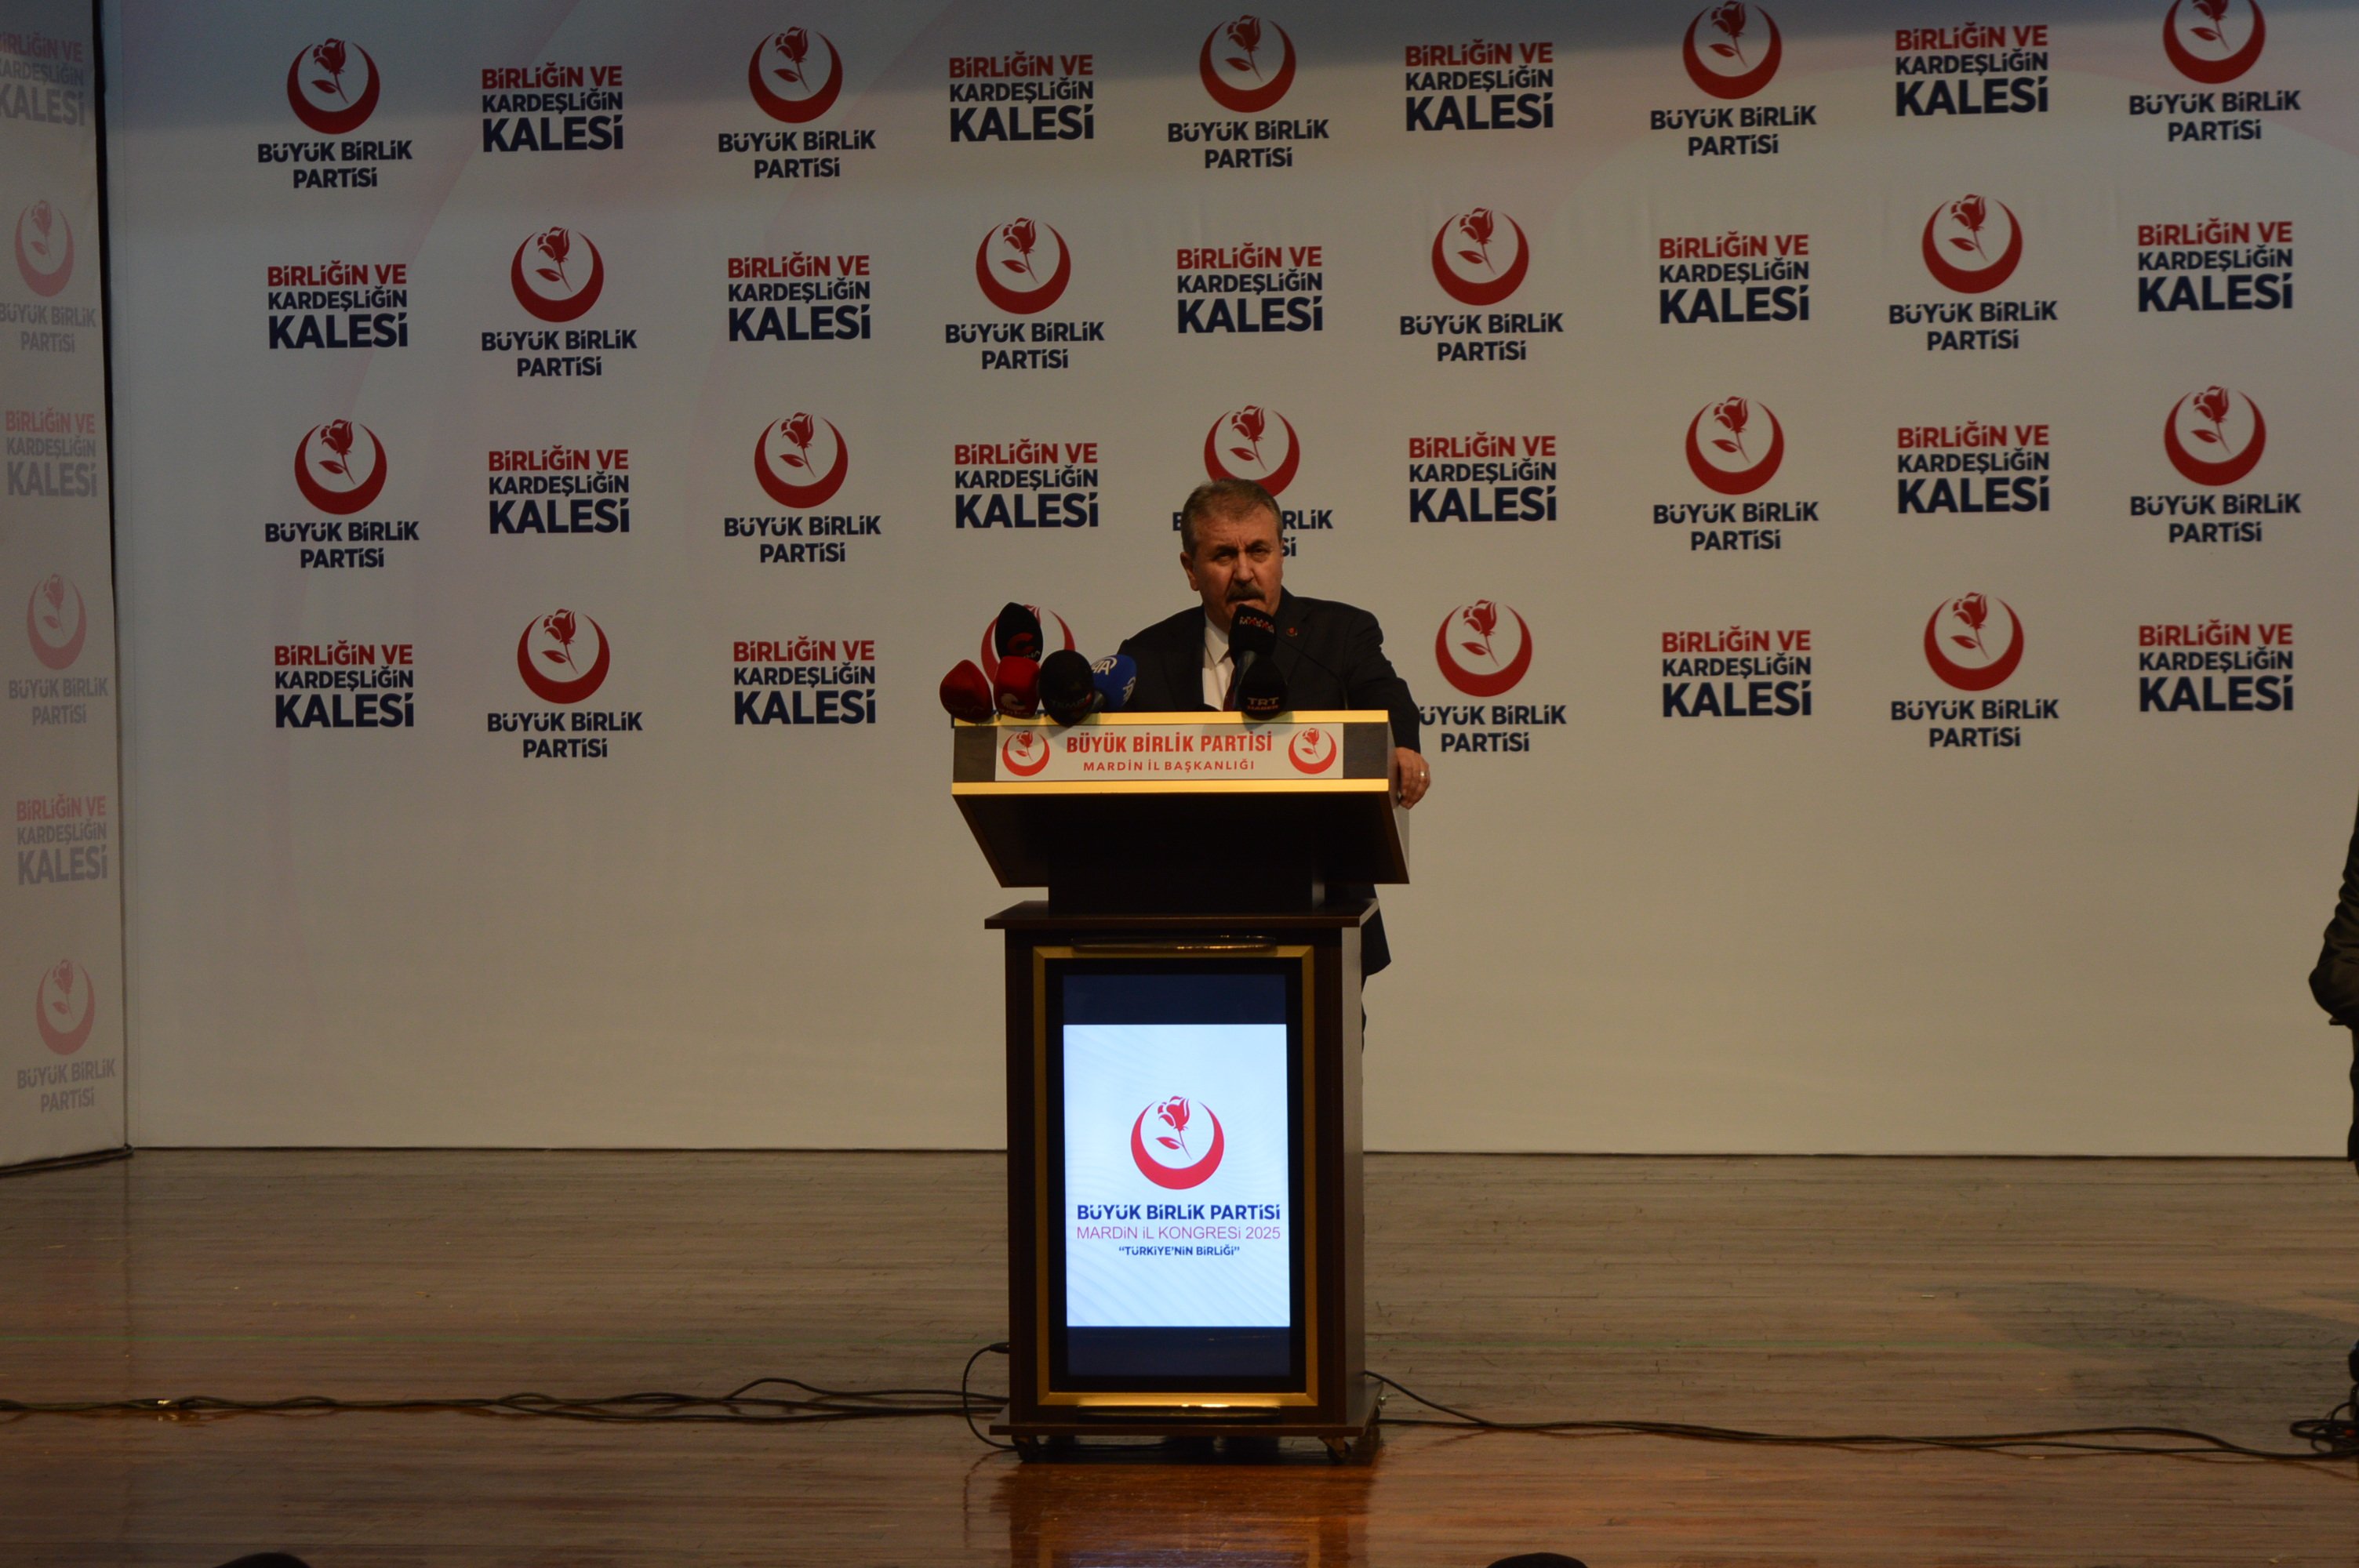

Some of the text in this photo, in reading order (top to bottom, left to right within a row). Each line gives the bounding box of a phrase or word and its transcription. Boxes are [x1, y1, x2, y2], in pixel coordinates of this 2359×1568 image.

[2013, 25, 2048, 47] VE
[1519, 42, 1553, 64] VE
[1060, 55, 1093, 76] VE
[591, 66, 622, 87] VE
[2257, 221, 2292, 243] VE
[1775, 234, 1808, 256] VE
[838, 256, 870, 276] VE
[1289, 246, 1322, 267] VE
[375, 264, 406, 285] VE
[1522, 436, 1556, 457] VE
[2015, 425, 2049, 447] VE
[597, 449, 628, 470] VE
[1065, 443, 1098, 464] VE
[1281, 510, 1333, 529] RLİK
[1777, 630, 1811, 652] VE
[2258, 624, 2293, 645] VE
[381, 644, 413, 665] VE
[842, 641, 874, 661] VE
[1247, 696, 1279, 706] TRT
[1419, 706, 1486, 726] ÜYÜK
[1067, 731, 1272, 753] BÜYÜK BİRLİK PARTİSİ
[1083, 758, 1255, 773] MARDİN İL BAŞKANLIĞI
[1245, 1226, 1281, 1240] 2025
